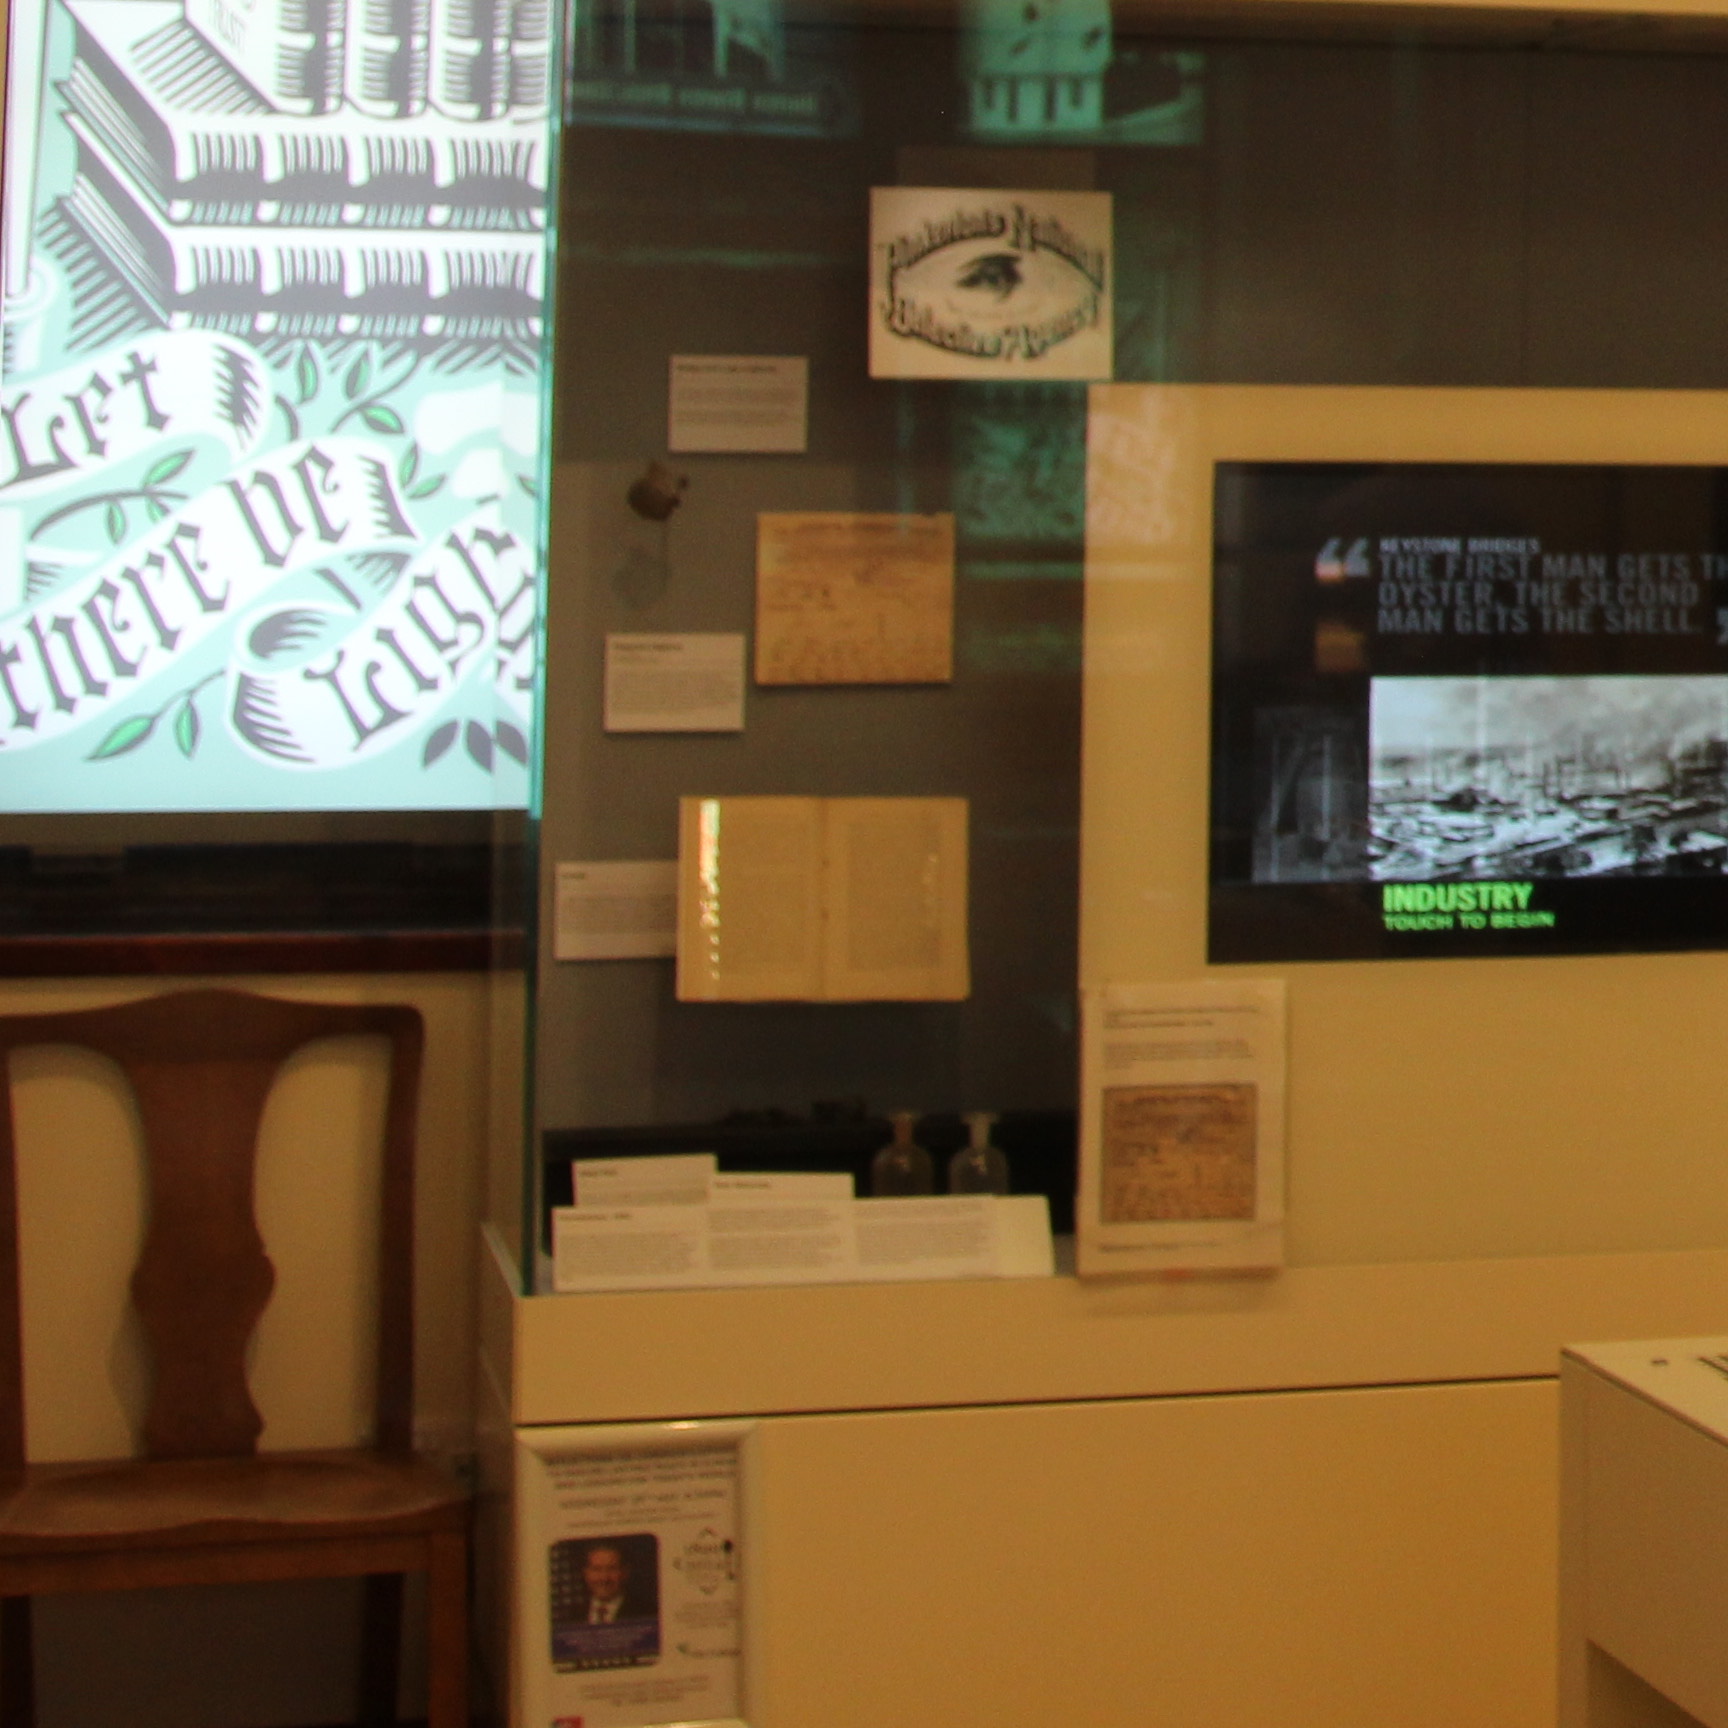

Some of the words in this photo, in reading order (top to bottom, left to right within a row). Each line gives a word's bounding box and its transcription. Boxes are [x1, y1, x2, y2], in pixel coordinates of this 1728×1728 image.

[1379, 553, 1431, 579] THE
[1446, 553, 1531, 579] FIRST
[1542, 554, 1609, 580] MAN
[1616, 554, 1693, 580] GETS
[1515, 580, 1571, 607] THE
[1578, 580, 1700, 608] SECOND
[1377, 607, 1443, 633] MAN
[1454, 607, 1530, 633] GETS
[1540, 607, 1598, 633] THE
[1383, 880, 1534, 912] INDUSTRY
[1459, 911, 1487, 930] TO
